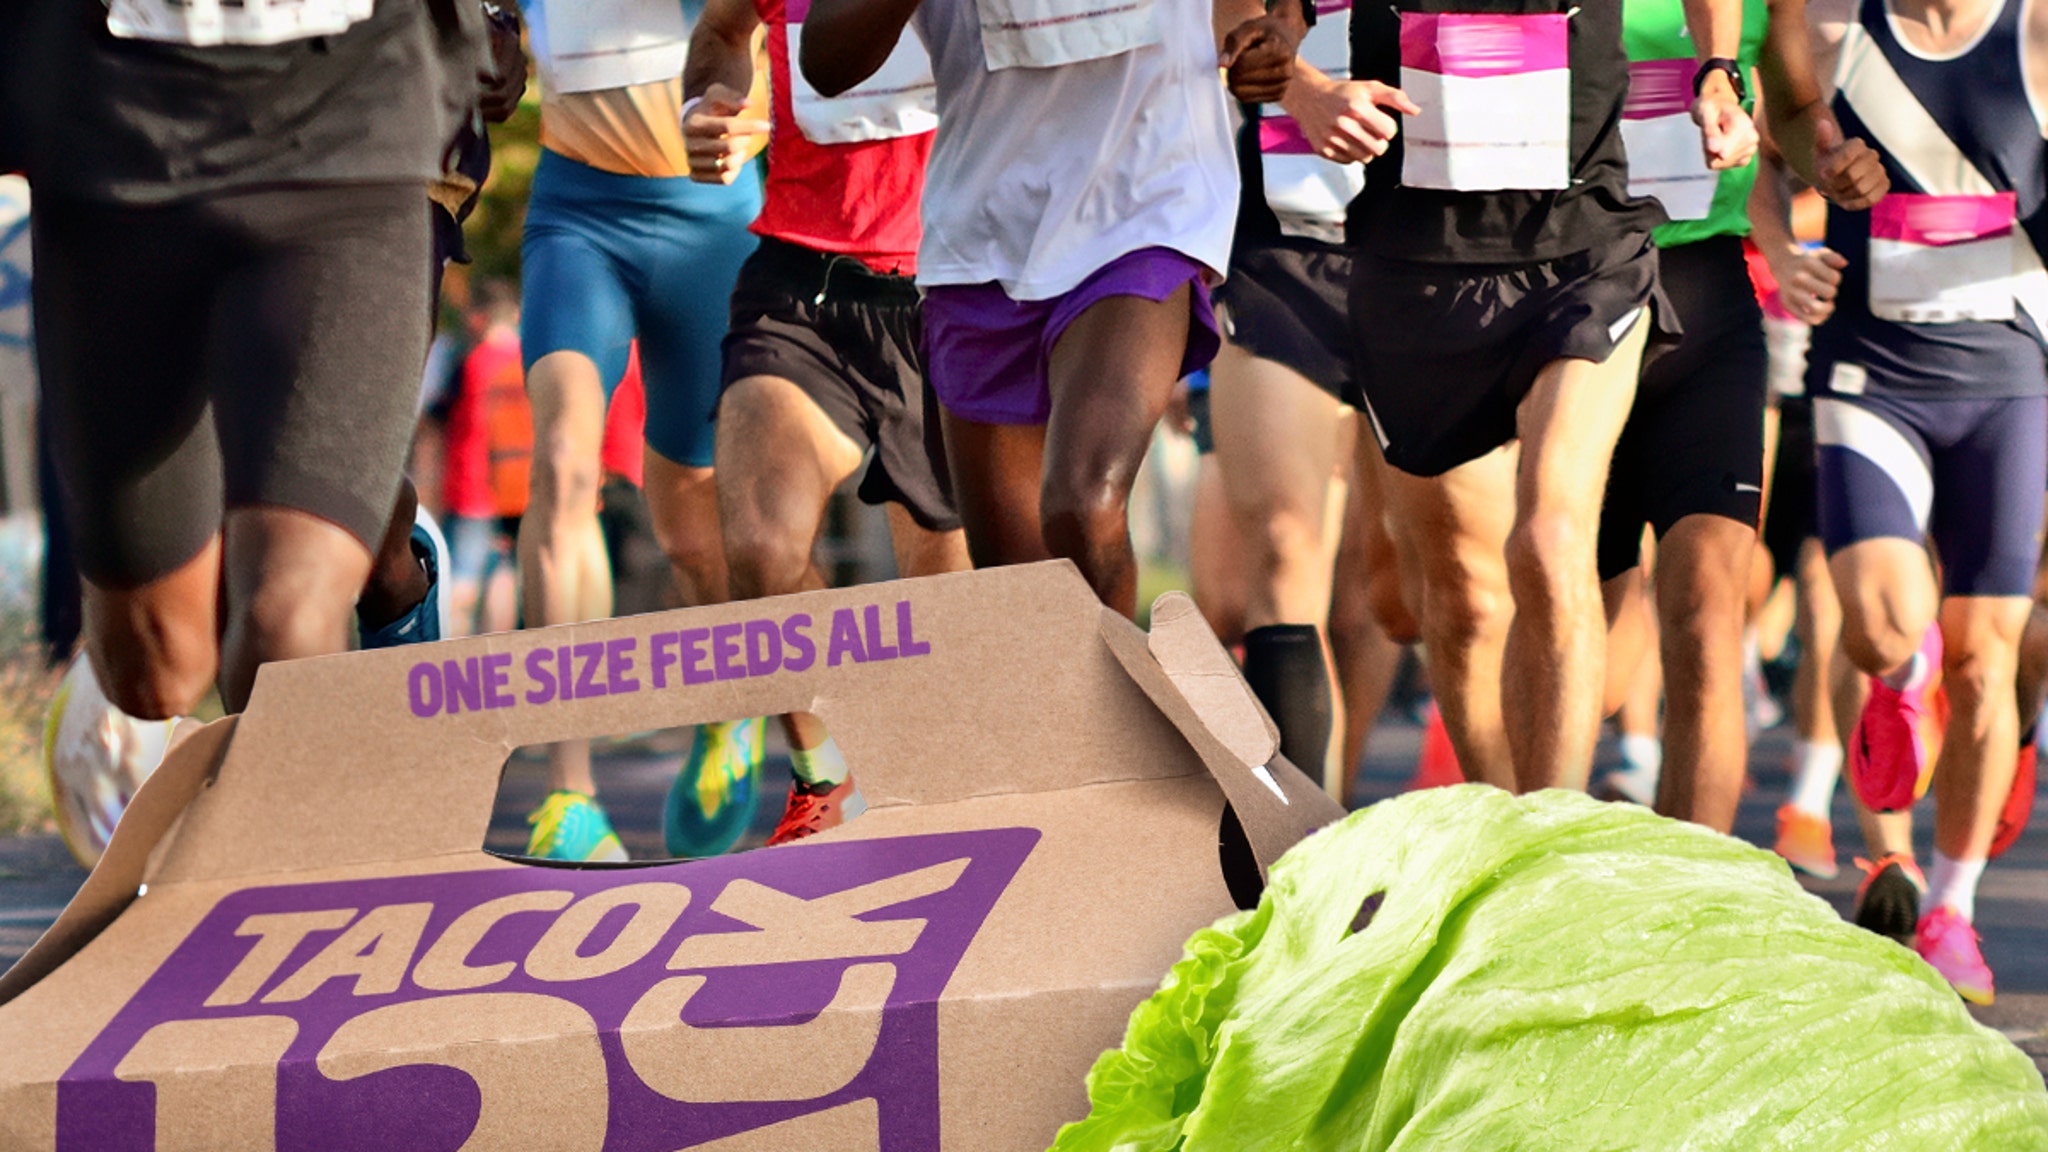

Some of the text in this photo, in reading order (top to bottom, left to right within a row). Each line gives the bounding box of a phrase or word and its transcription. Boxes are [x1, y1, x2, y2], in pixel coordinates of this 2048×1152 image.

[408, 601, 931, 718] ONE SIZE FEEDS ALL
[203, 881, 692, 1008] TACO
